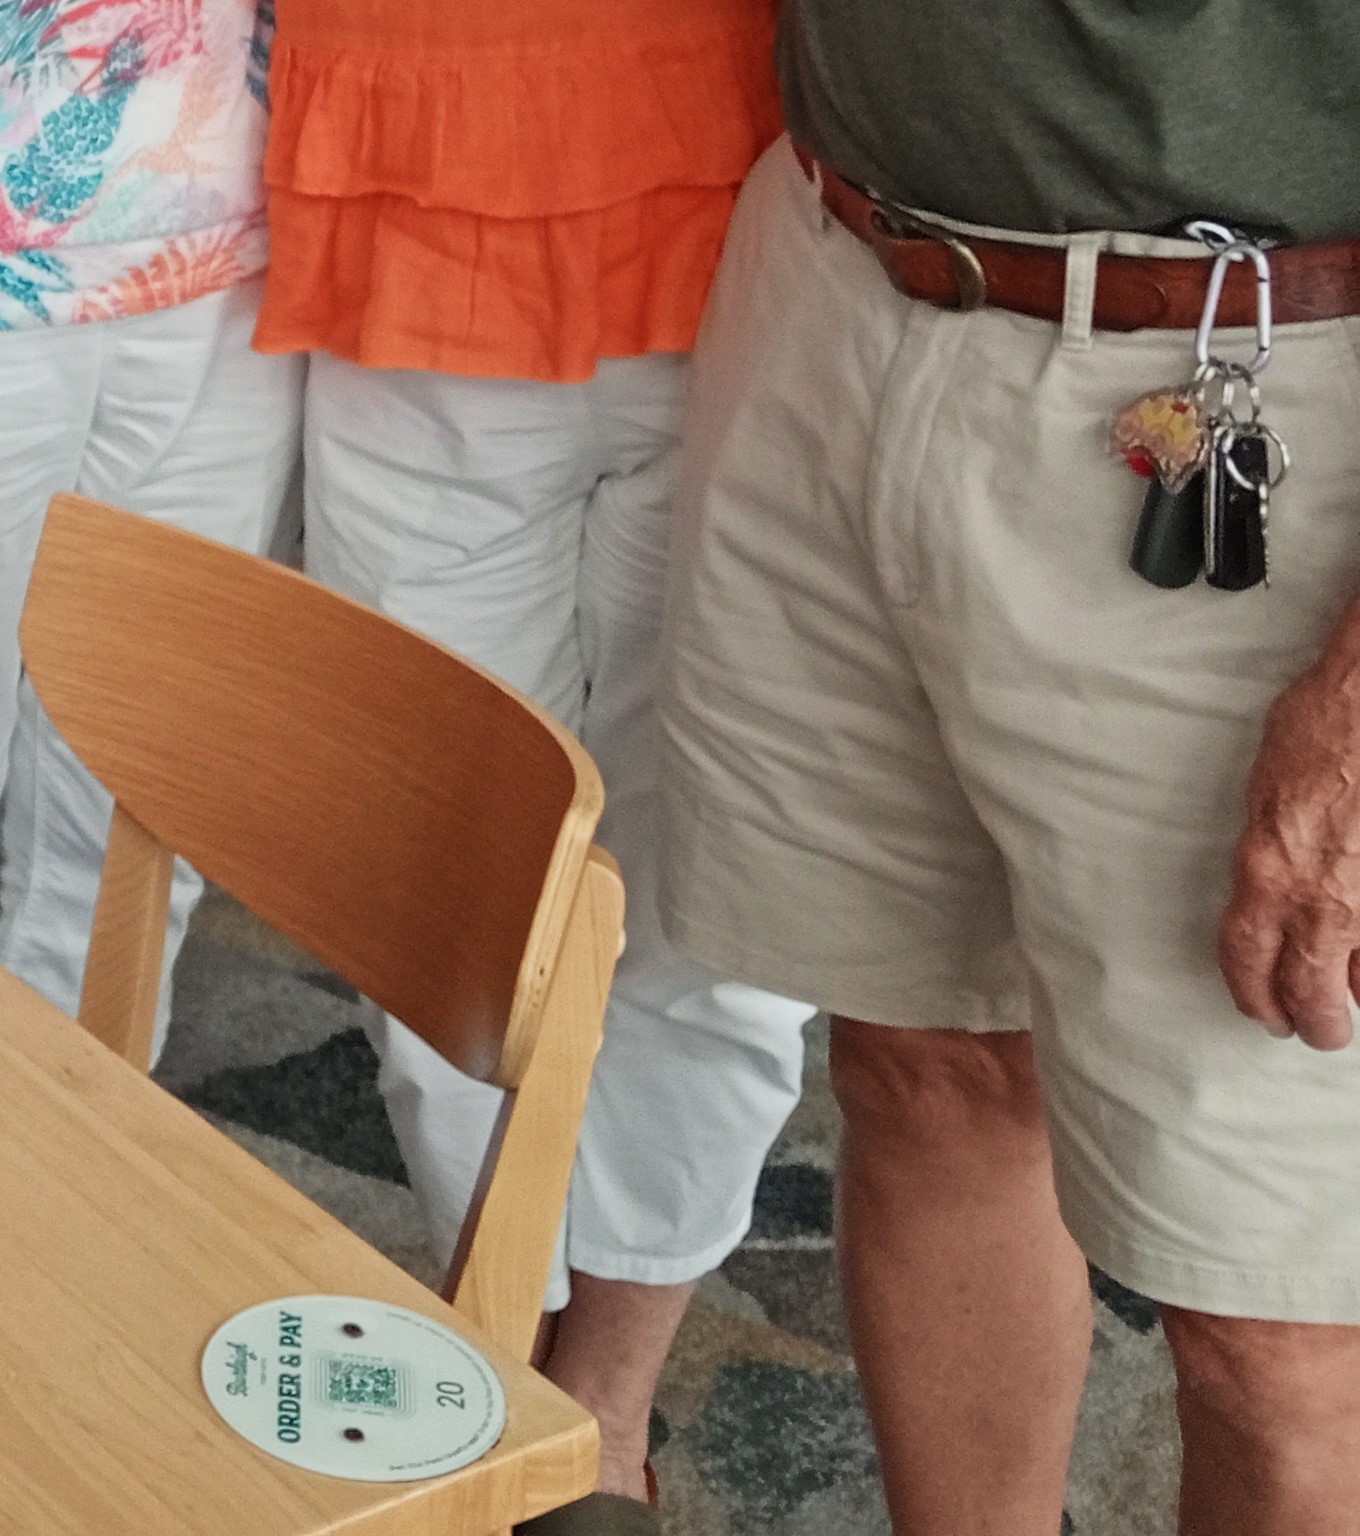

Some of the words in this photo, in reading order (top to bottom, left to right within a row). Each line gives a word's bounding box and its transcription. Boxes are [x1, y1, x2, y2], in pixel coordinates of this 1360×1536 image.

[279, 1310, 303, 1348] PAY
[279, 1353, 302, 1369] &
[276, 1371, 302, 1444] ORDER
[436, 1381, 465, 1410] 20
